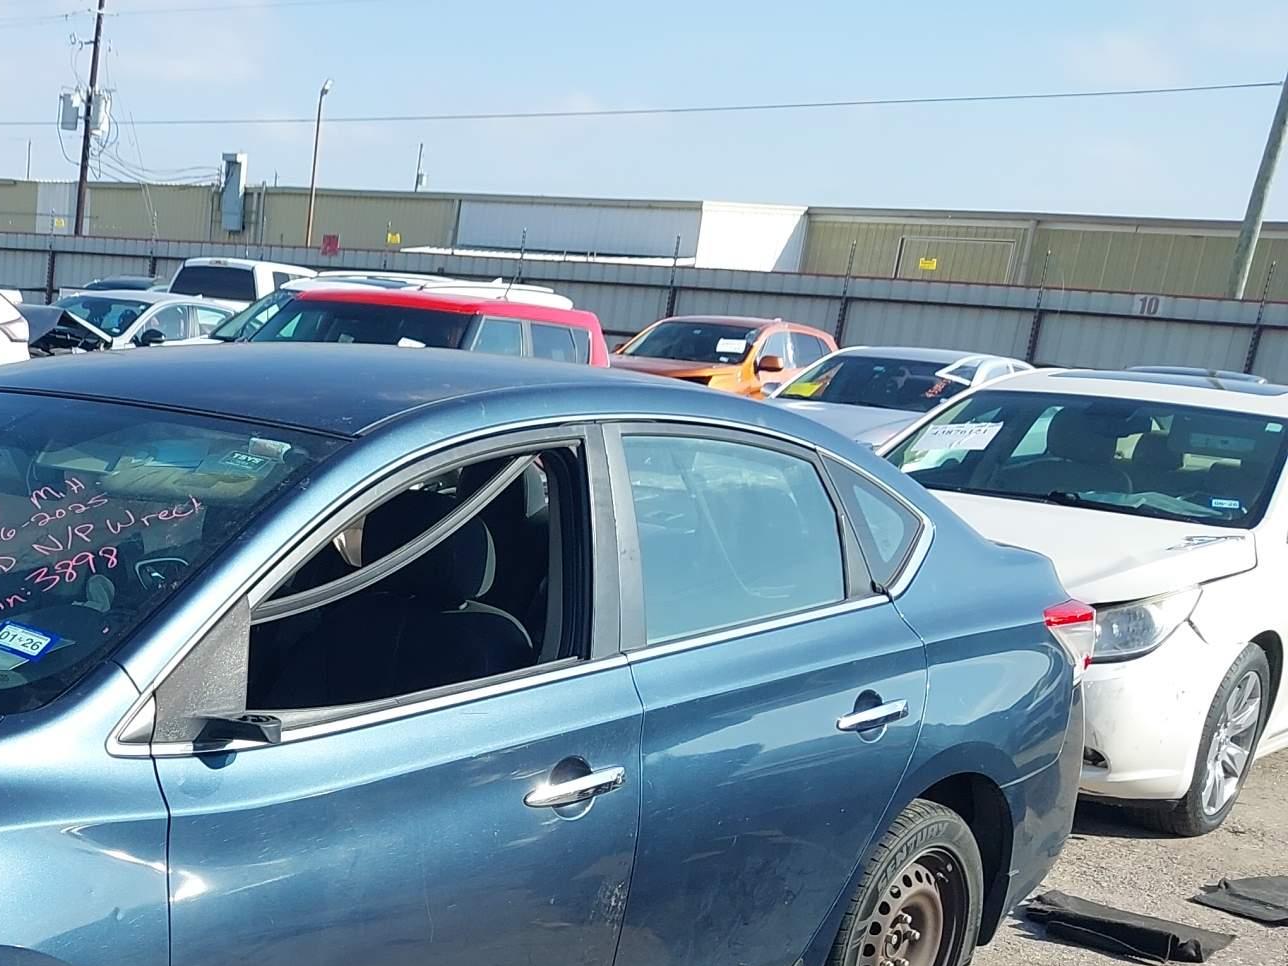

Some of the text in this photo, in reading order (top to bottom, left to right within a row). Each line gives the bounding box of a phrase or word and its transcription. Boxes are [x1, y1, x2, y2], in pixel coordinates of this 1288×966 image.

[1139, 296, 1160, 315] 10
[25, 546, 119, 593] 3898
[21, 637, 43, 651] 26
[876, 821, 949, 894] SENTURY
